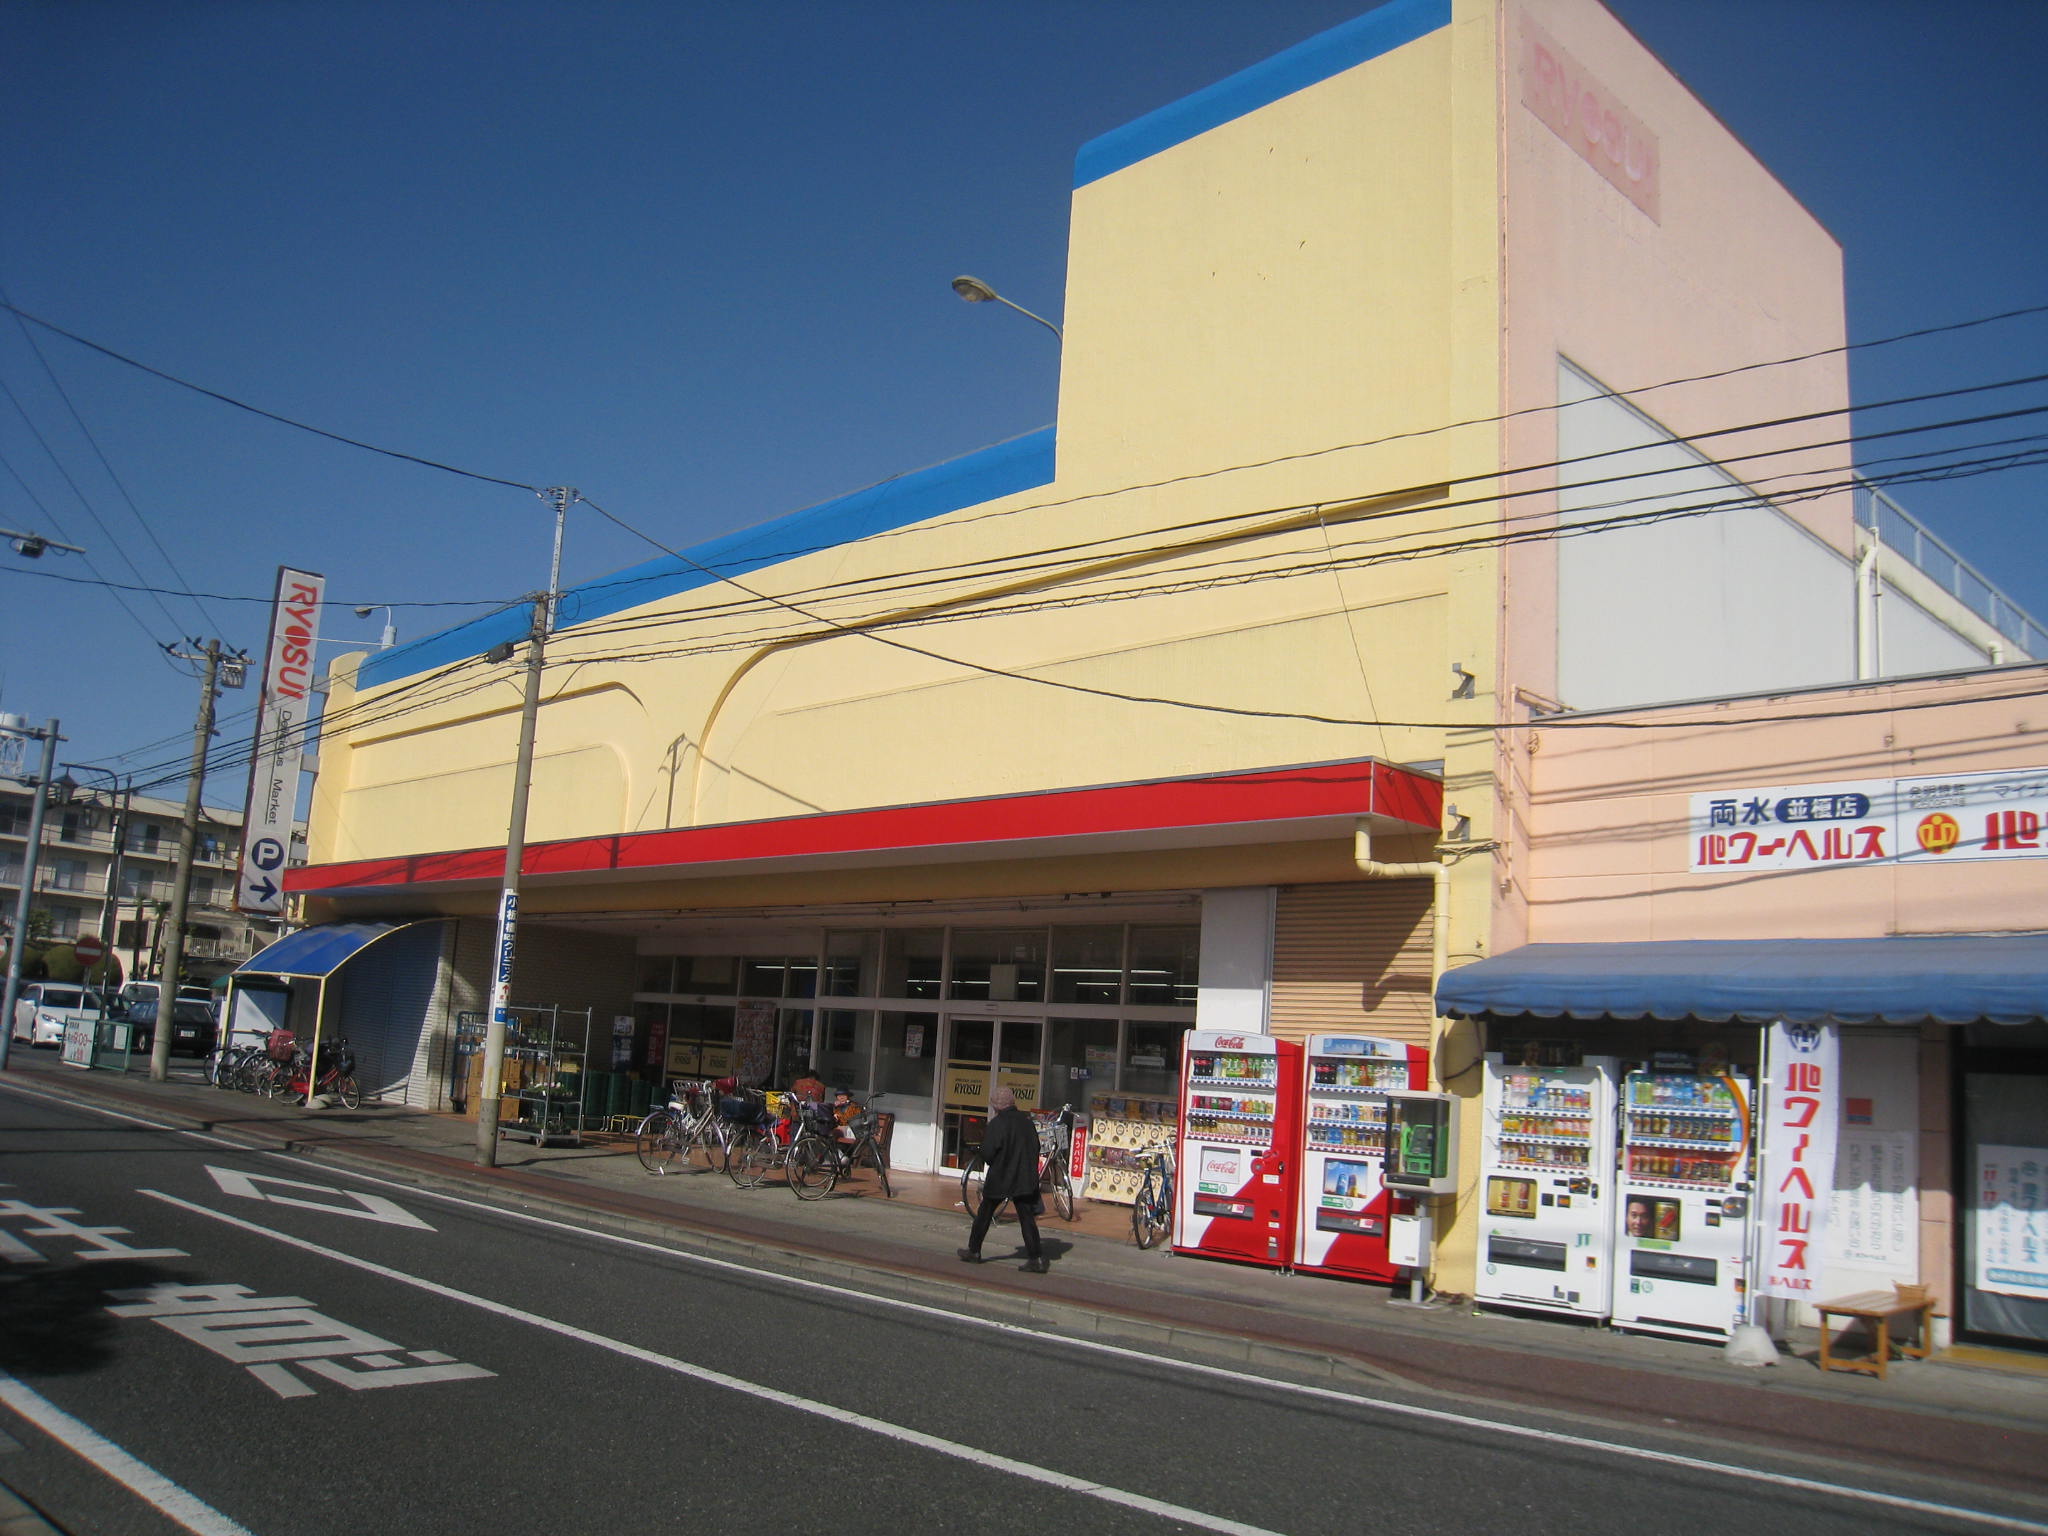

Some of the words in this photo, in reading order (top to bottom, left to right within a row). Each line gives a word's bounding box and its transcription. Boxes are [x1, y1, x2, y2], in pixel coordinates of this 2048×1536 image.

[277, 583, 317, 699] RYOSUI
[269, 779, 283, 825] Market
[1993, 782, 2048, 799] マイナ
[1697, 825, 1887, 866] パワーヘルス
[1980, 810, 2048, 851] パ
[954, 1083, 982, 1096] RYOSUI
[1012, 1087, 1035, 1101] YOSUI
[1777, 1062, 1822, 1270] パワーヘルス
